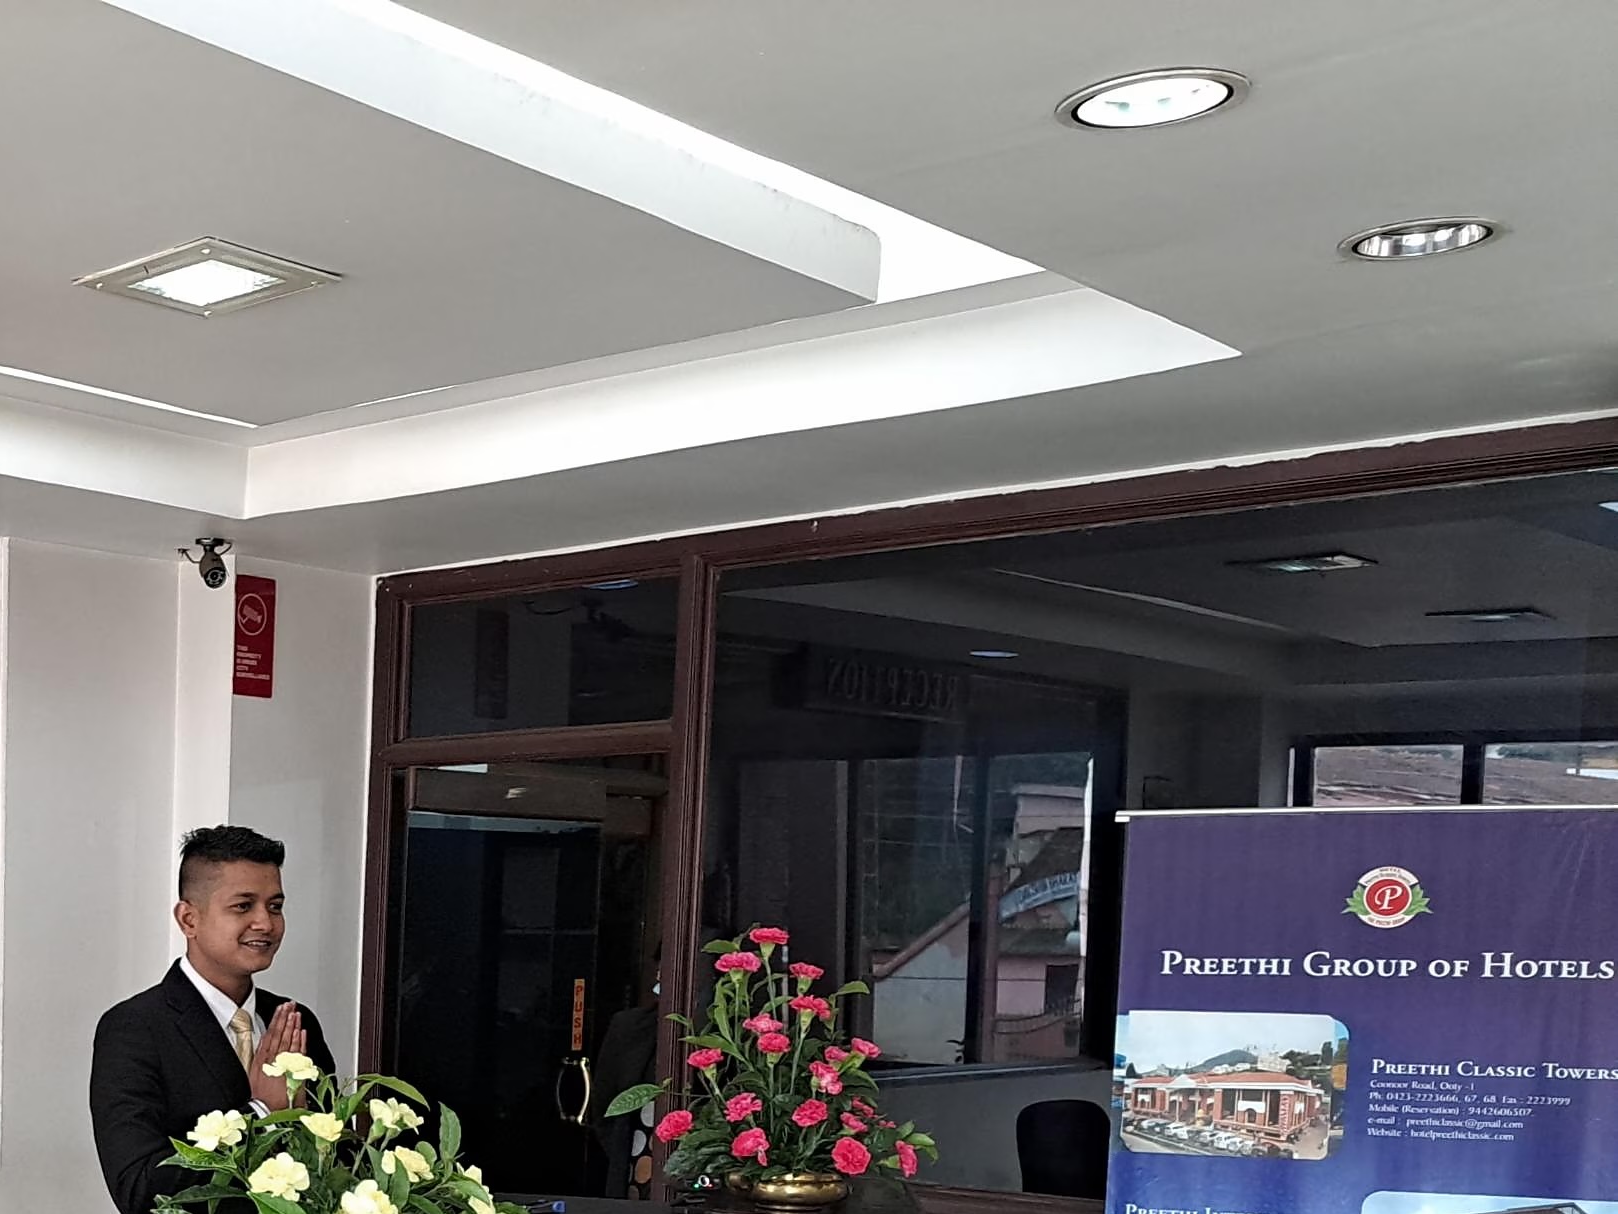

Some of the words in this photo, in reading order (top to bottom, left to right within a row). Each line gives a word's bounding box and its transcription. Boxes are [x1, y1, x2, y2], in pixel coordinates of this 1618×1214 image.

[1160, 950, 1292, 976] PREETHI
[1303, 951, 1417, 978] GROUP
[1428, 959, 1470, 978] OF
[1481, 952, 1615, 979] HOTELS
[573, 984, 584, 1045] PUSH
[1371, 1058, 1450, 1076] PREETHI
[1457, 1061, 1535, 1078] CLASSIC
[1542, 1062, 1618, 1080] TOWERS
